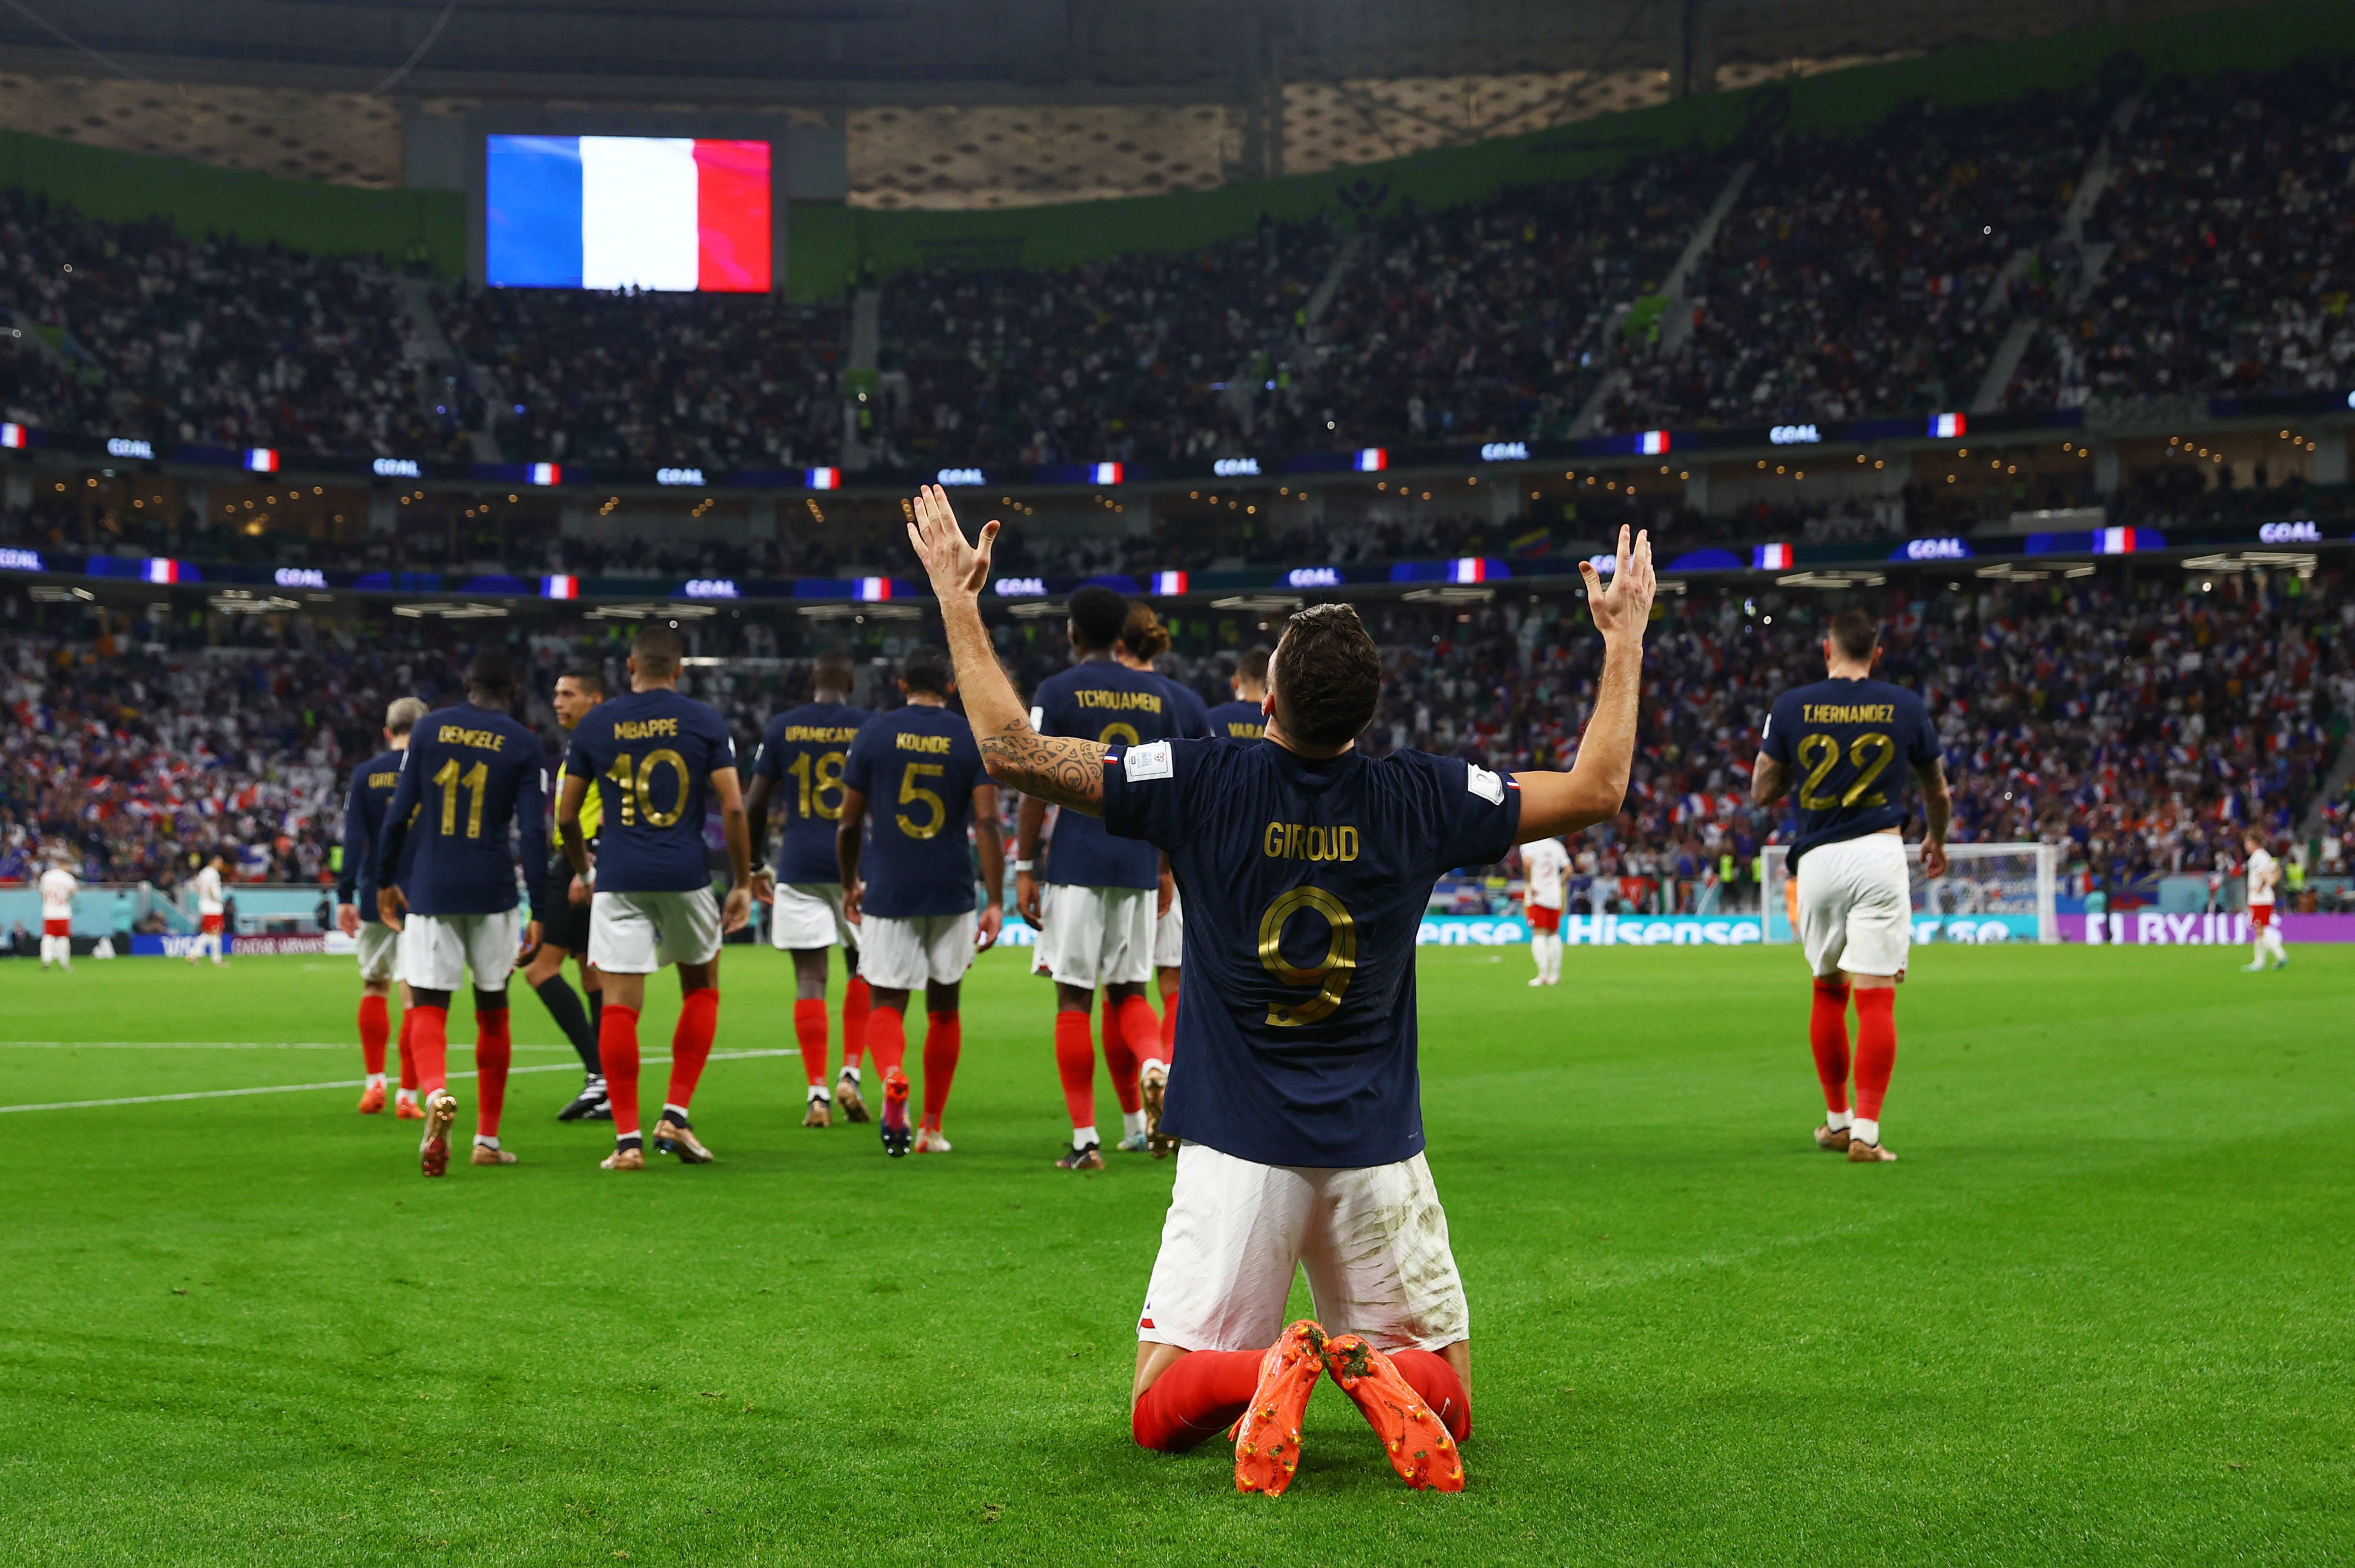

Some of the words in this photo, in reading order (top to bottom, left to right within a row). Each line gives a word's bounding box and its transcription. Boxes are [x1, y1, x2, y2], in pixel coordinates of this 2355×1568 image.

[1770, 424, 1820, 444] GOAL
[107, 438, 154, 459] GOAL
[1481, 443, 1528, 460] GOAL
[373, 459, 420, 477] GOAL
[657, 469, 705, 485] GOAL
[937, 469, 986, 485] GOAL
[1214, 459, 1260, 476] GOAL
[2259, 521, 2321, 543] GOAL
[1908, 539, 1964, 559] GOAL
[275, 568, 327, 587] GOAL
[995, 578, 1047, 596] GOAL
[1289, 568, 1339, 587] GOAL
[685, 580, 738, 598] GOAL
[1074, 689, 1162, 715] TCHOUAMENI
[1802, 704, 1895, 723] T.HERNANDEZ
[438, 725, 506, 752] DEMBELE
[614, 717, 678, 740] MBAPPE
[1227, 722, 1264, 740] VARA
[895, 732, 953, 755] KOUNDE
[1797, 732, 1895, 810] 22
[605, 748, 690, 828] 10
[788, 750, 848, 820] 18
[433, 758, 489, 839] 11
[895, 762, 946, 840] 5
[1264, 821, 1359, 862] GIROUD
[1415, 922, 1524, 945] ense
[1567, 914, 1761, 945] Hisense
[1258, 885, 1356, 1027] 9
